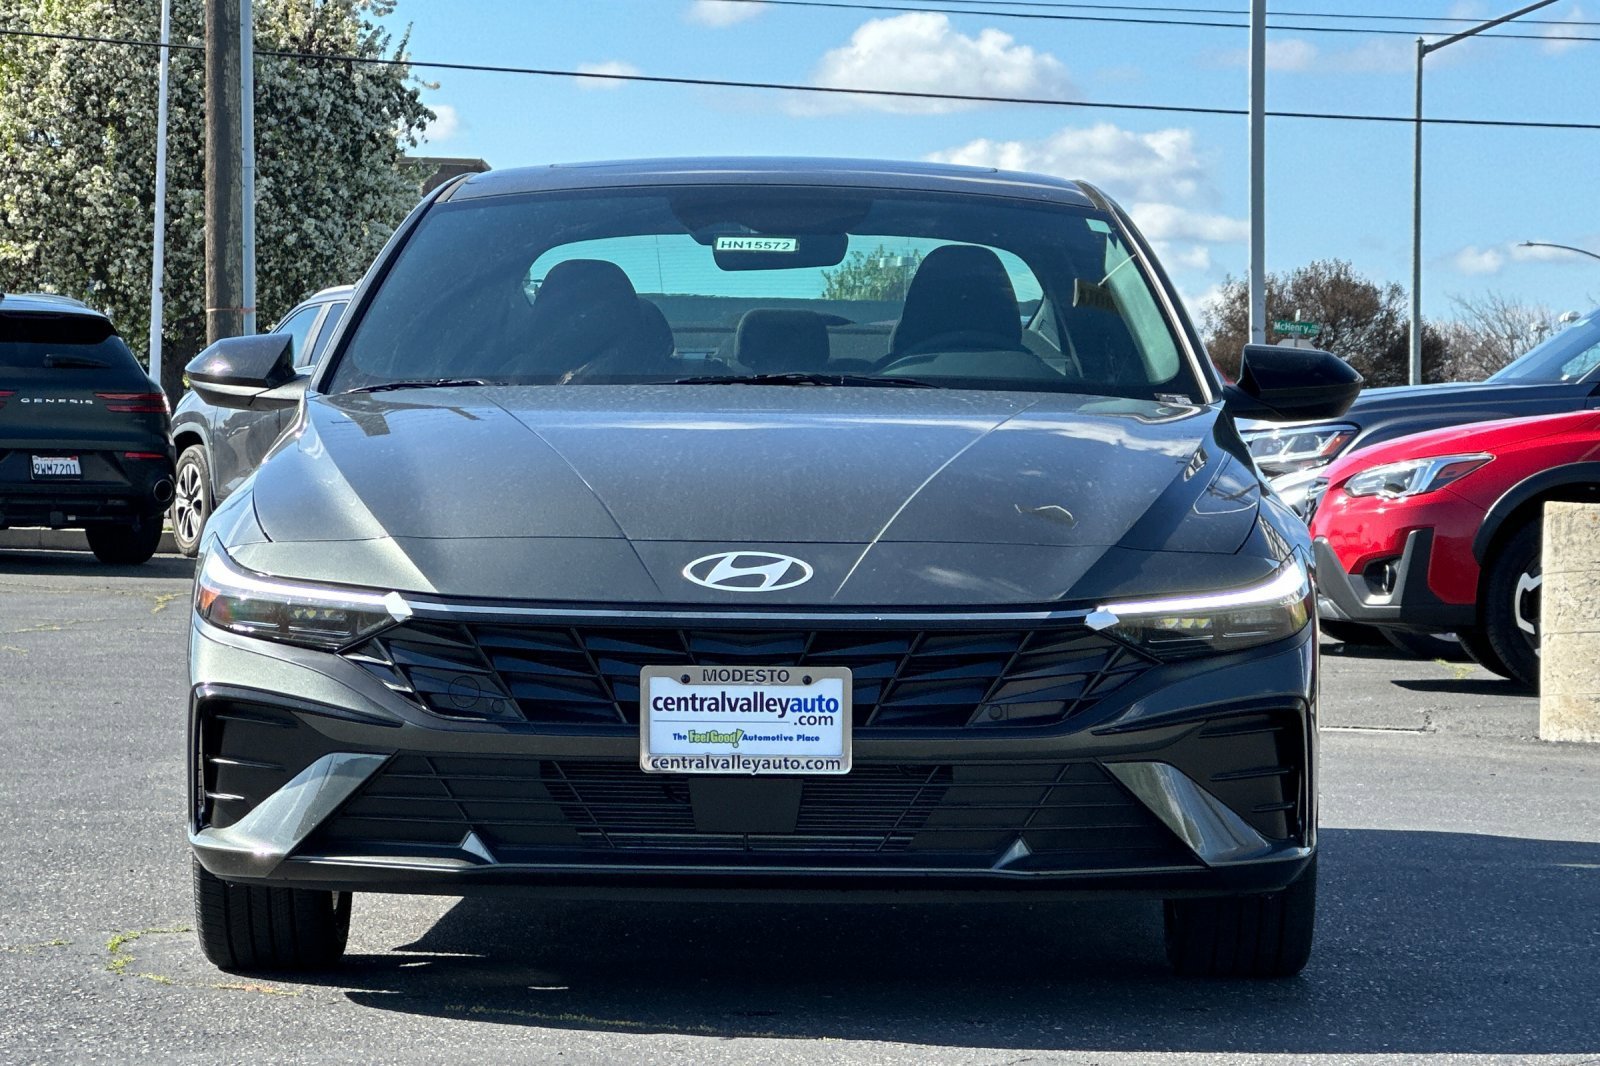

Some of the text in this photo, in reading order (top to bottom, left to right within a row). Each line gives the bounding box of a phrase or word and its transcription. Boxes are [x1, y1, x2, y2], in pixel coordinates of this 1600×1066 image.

[721, 240, 791, 250] HN15572
[1274, 321, 1309, 334] McHenry
[702, 669, 790, 683] MODESTO
[652, 691, 839, 718] centralvalleyauto
[793, 714, 834, 726] .com
[672, 733, 687, 741] The
[741, 733, 794, 742] Automotive
[796, 733, 820, 741] Place
[651, 755, 841, 774] centralvalleyauto.com
